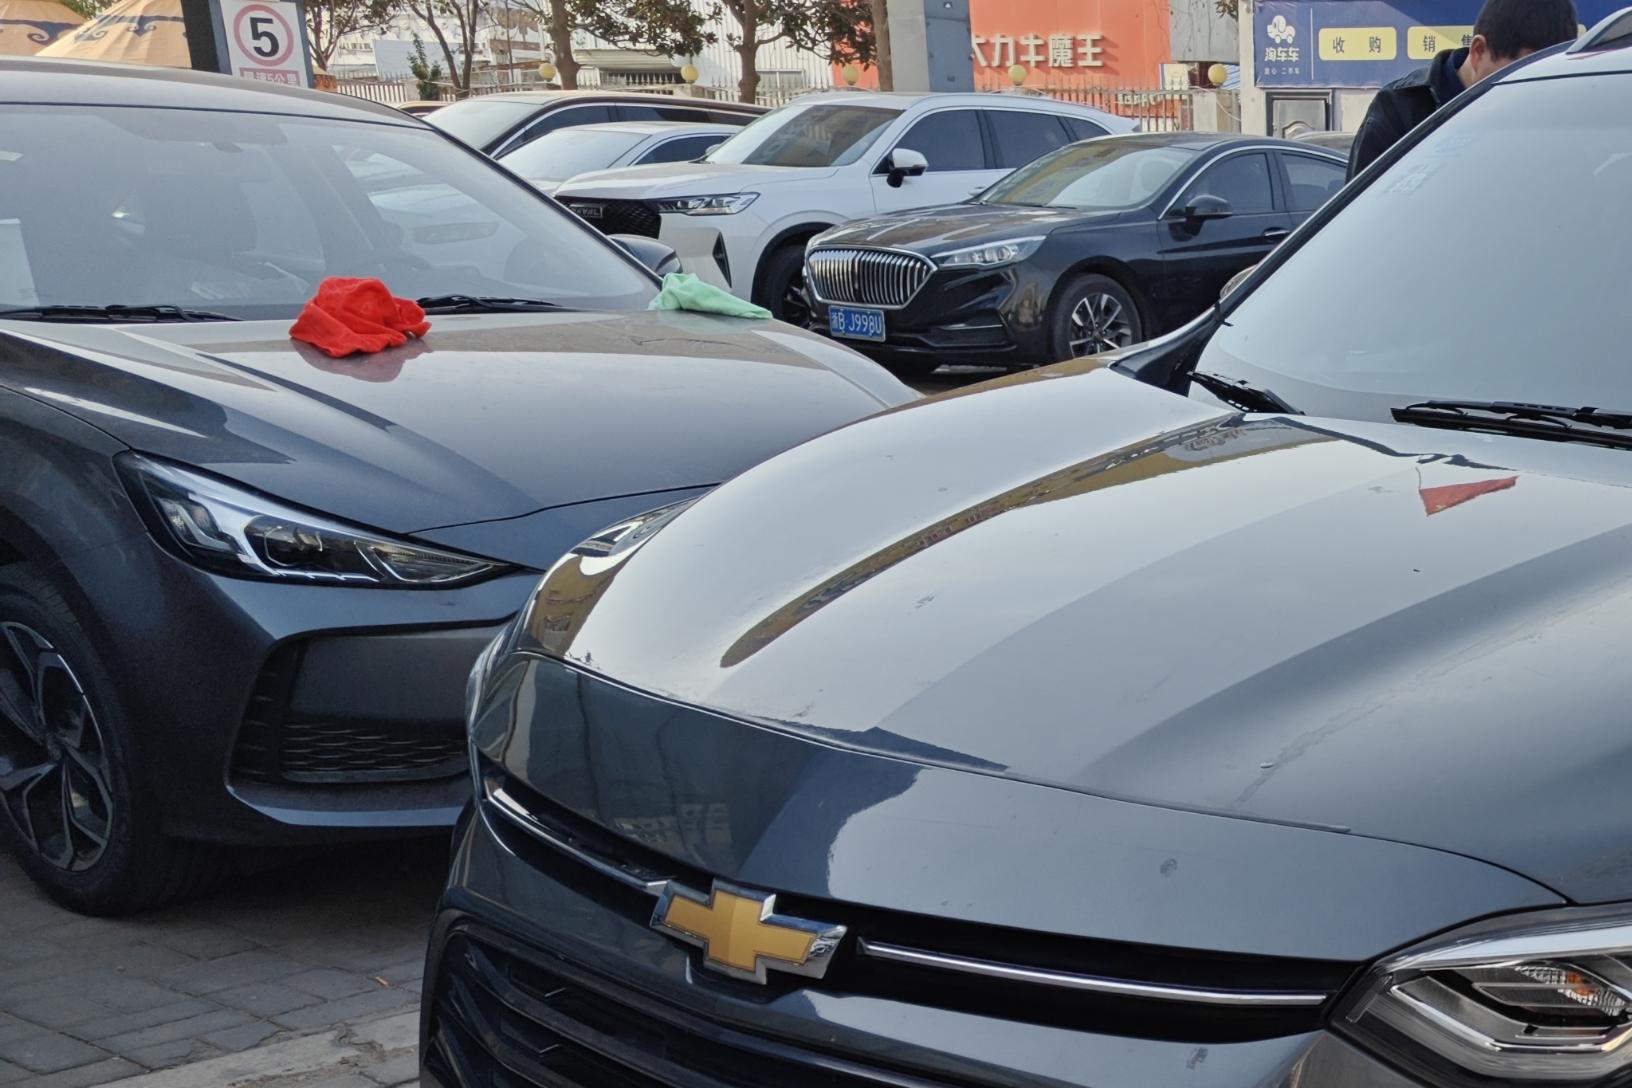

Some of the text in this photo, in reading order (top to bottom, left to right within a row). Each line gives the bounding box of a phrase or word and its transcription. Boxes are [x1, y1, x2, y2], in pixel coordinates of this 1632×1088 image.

[250, 17, 279, 57] 5
[1265, 47, 1299, 62] 淘车车
